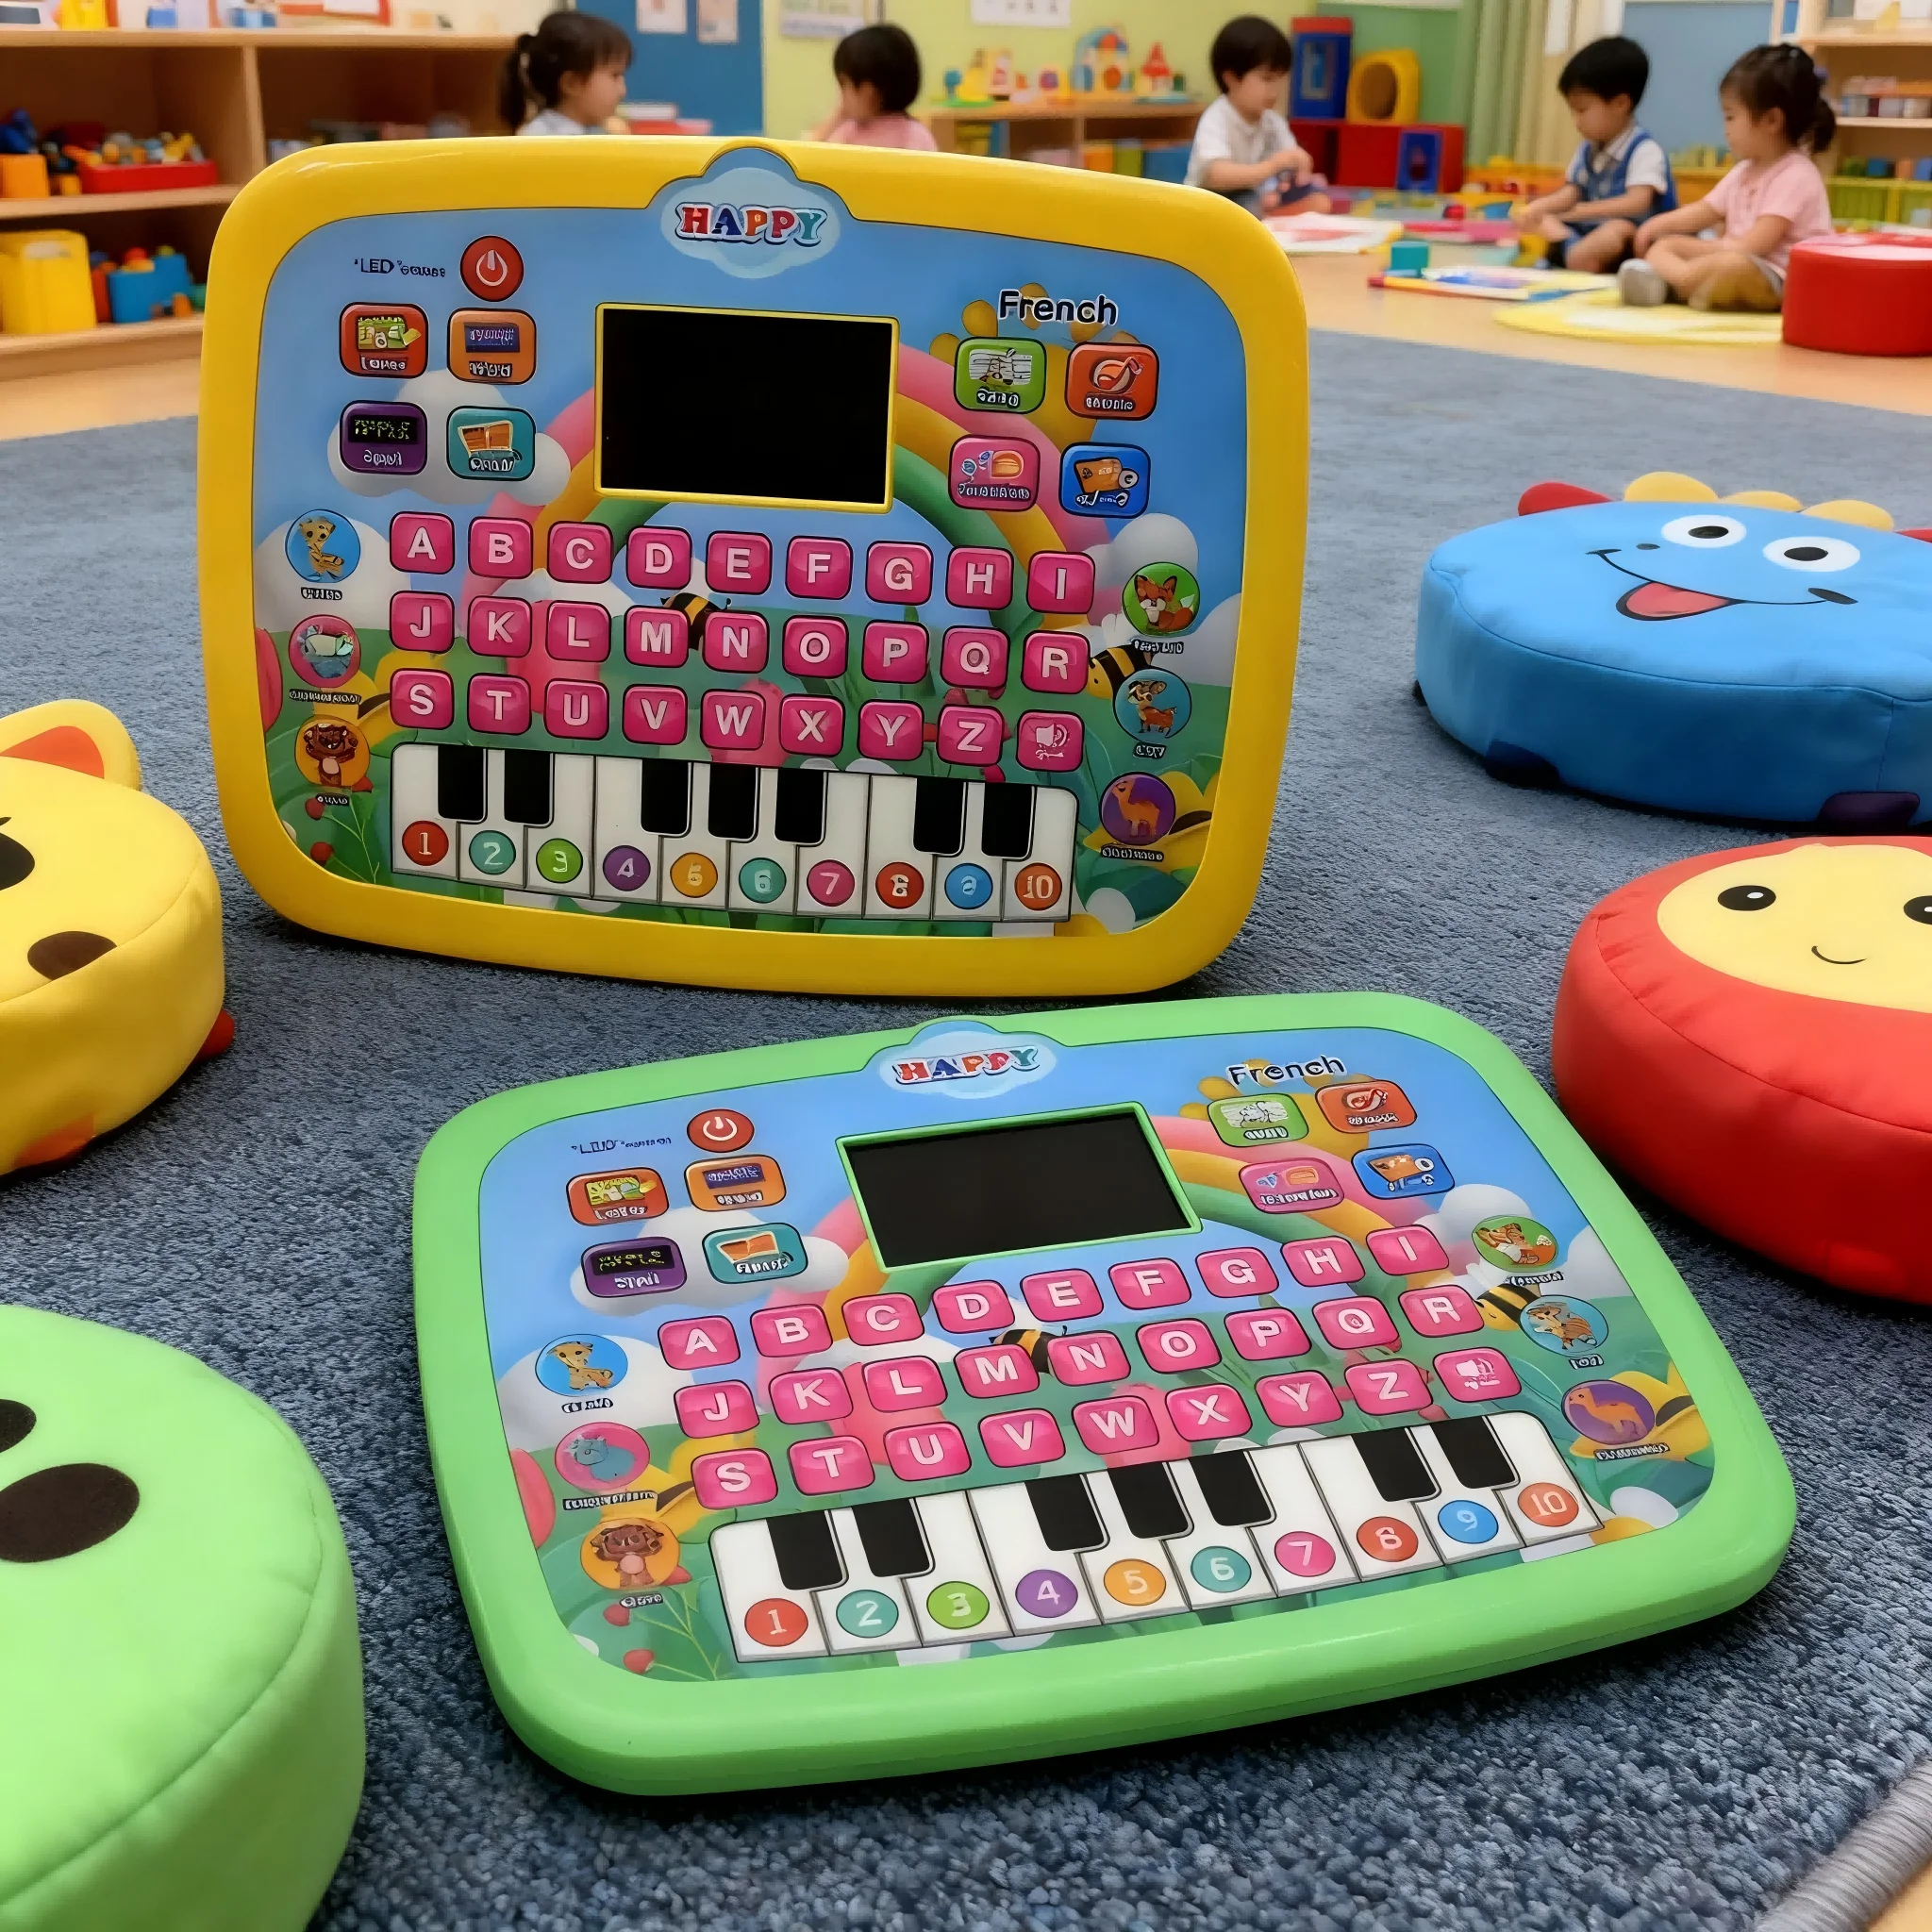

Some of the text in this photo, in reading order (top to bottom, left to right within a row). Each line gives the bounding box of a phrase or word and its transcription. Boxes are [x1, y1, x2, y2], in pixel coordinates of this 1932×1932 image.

[681, 207, 824, 240] HAPPY
[1000, 291, 1117, 325] French
[408, 527, 1066, 600] A B C D E F G H I
[409, 606, 1068, 680] J K L M N O P Q R
[409, 684, 986, 752] S T U V W X Y Z
[419, 833, 430, 856] 1
[482, 842, 503, 866] 2
[553, 851, 568, 872] 3
[820, 873, 840, 894] 7
[1024, 875, 1053, 898] 10
[897, 1048, 1034, 1081] HAPPY
[1228, 1055, 1345, 1085] French
[685, 1237, 1417, 1355] A B C D E F G H I
[703, 1296, 1461, 1421] J K L M N O P Q R
[716, 1372, 1409, 1492] S T U V W X Y Z
[768, 1491, 1567, 1635] 1 2 3 4 5 6 7 8 9 10
